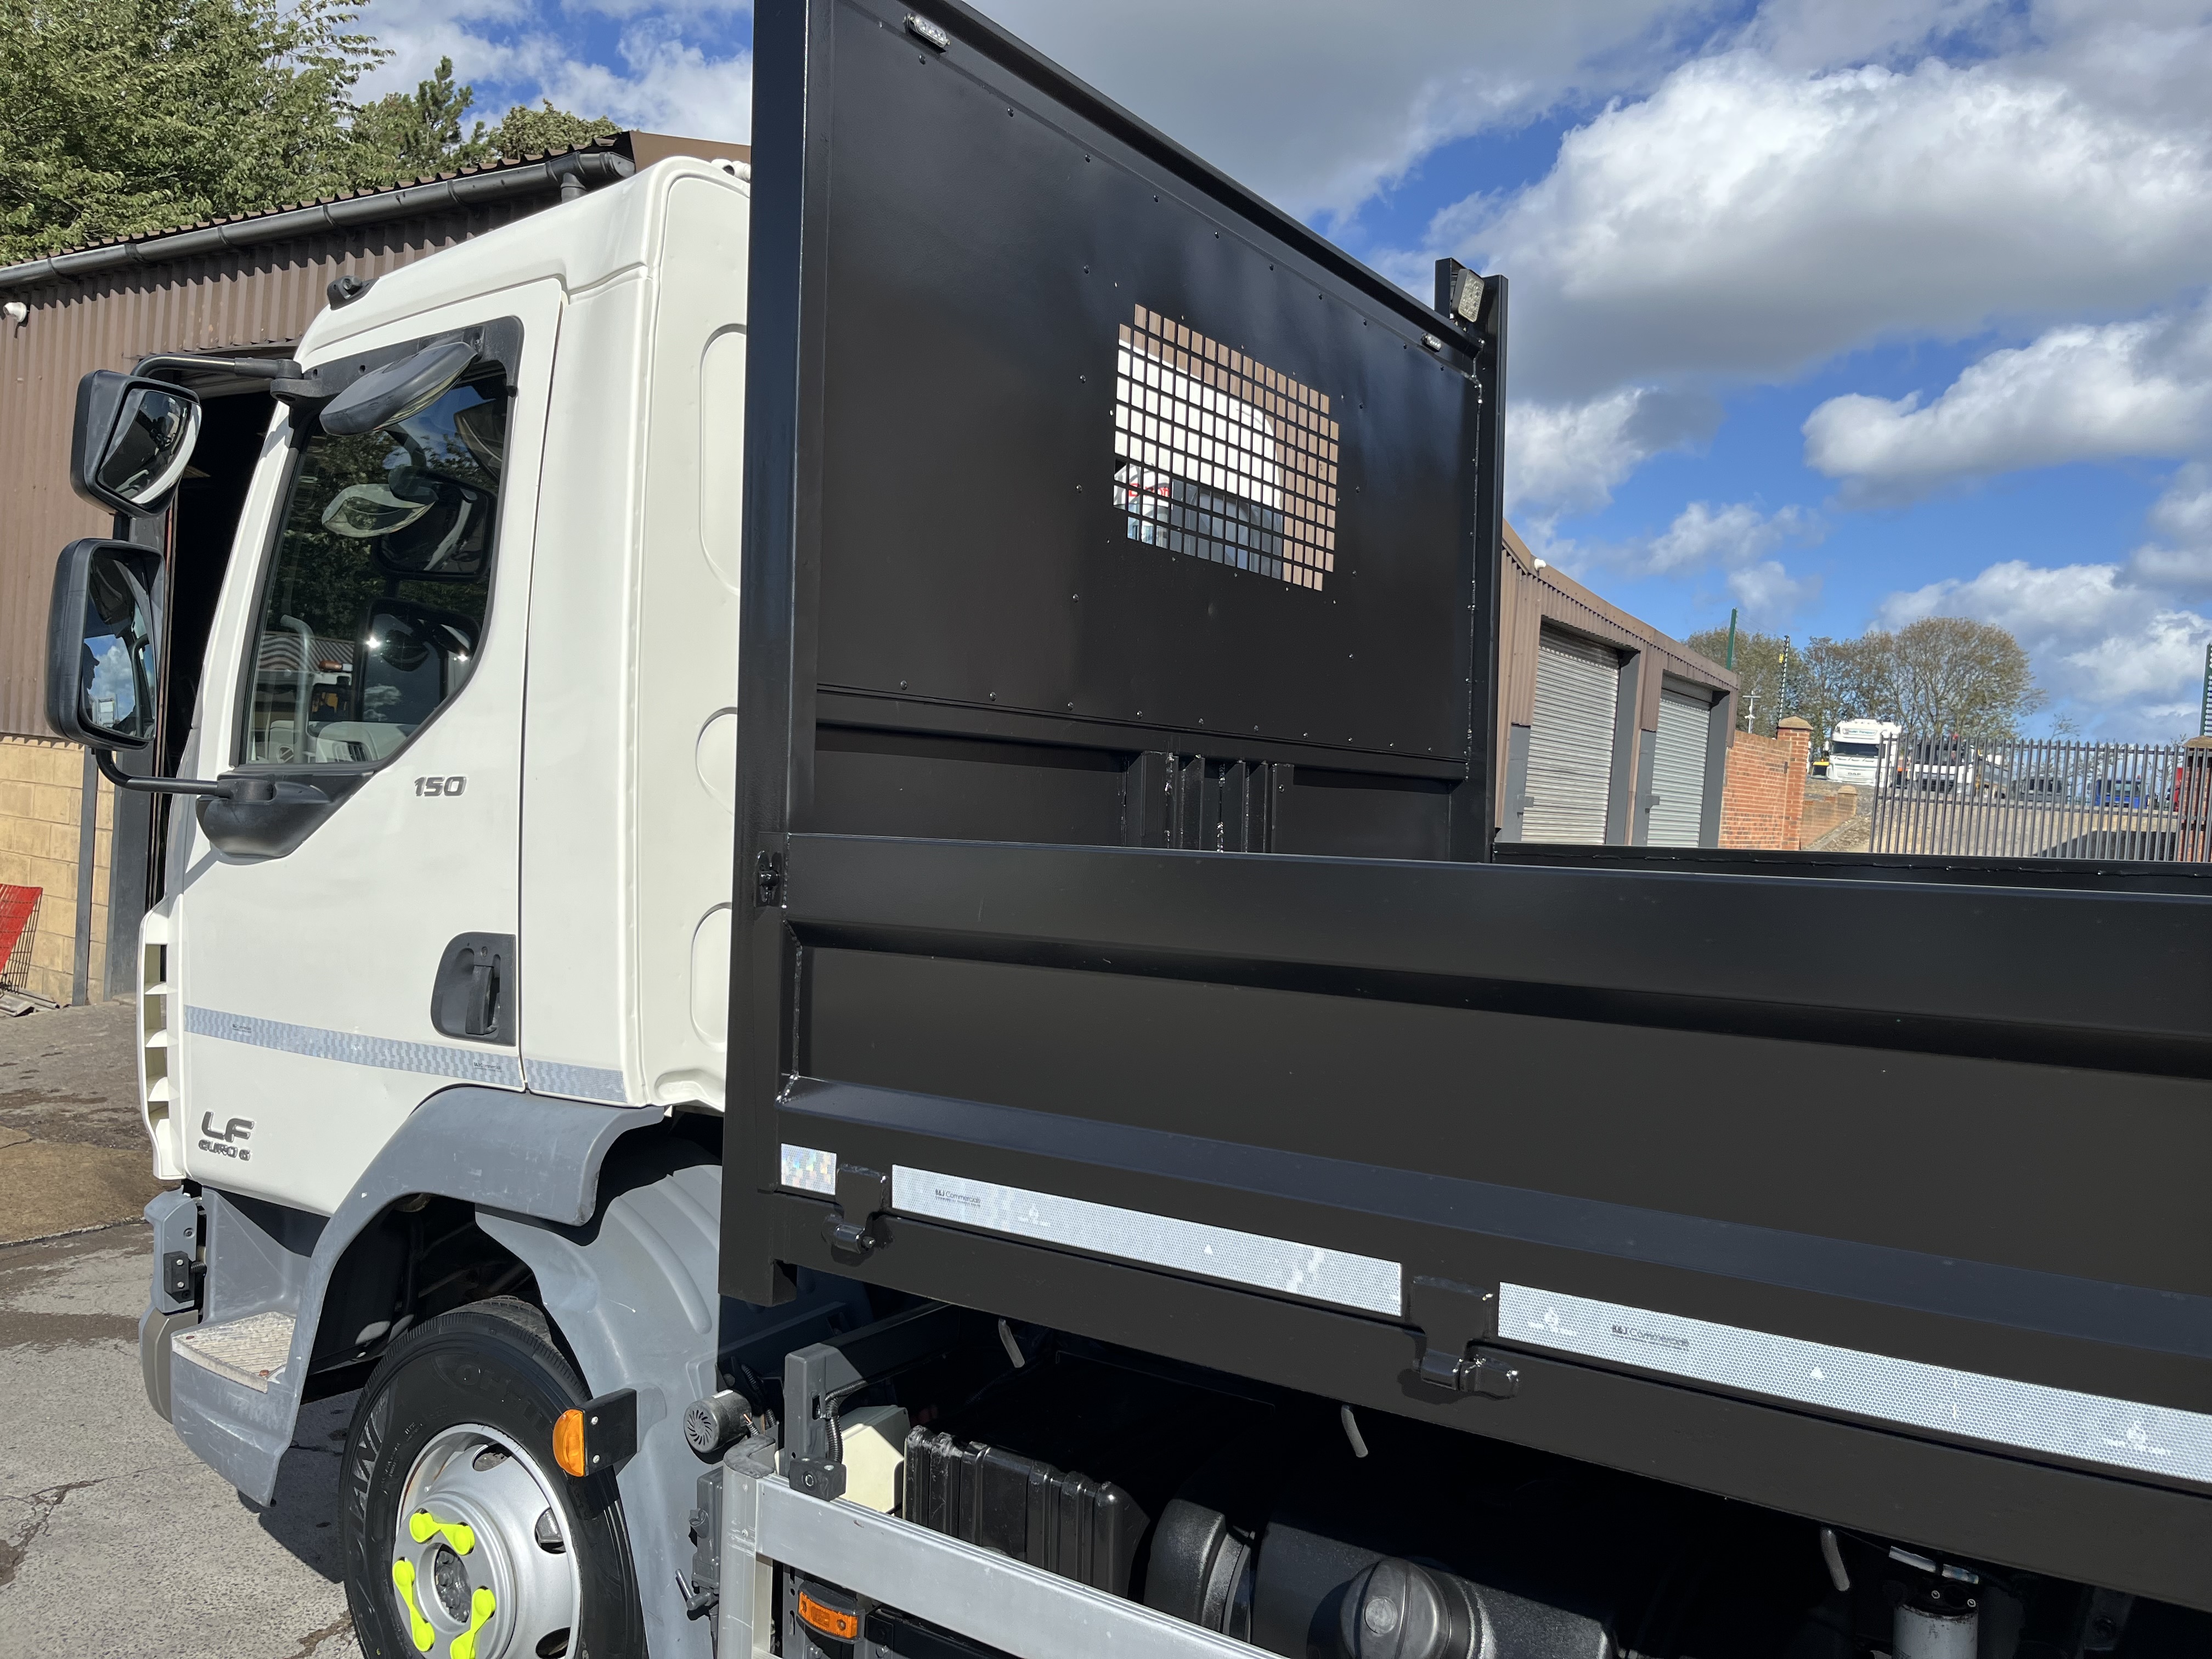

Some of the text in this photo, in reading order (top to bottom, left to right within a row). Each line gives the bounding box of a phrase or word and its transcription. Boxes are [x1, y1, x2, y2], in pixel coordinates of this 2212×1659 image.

[414, 776, 467, 797] 150
[201, 1111, 255, 1143] LF
[198, 1139, 251, 1161] EURO 6
[946, 1190, 981, 1204] Commercials
